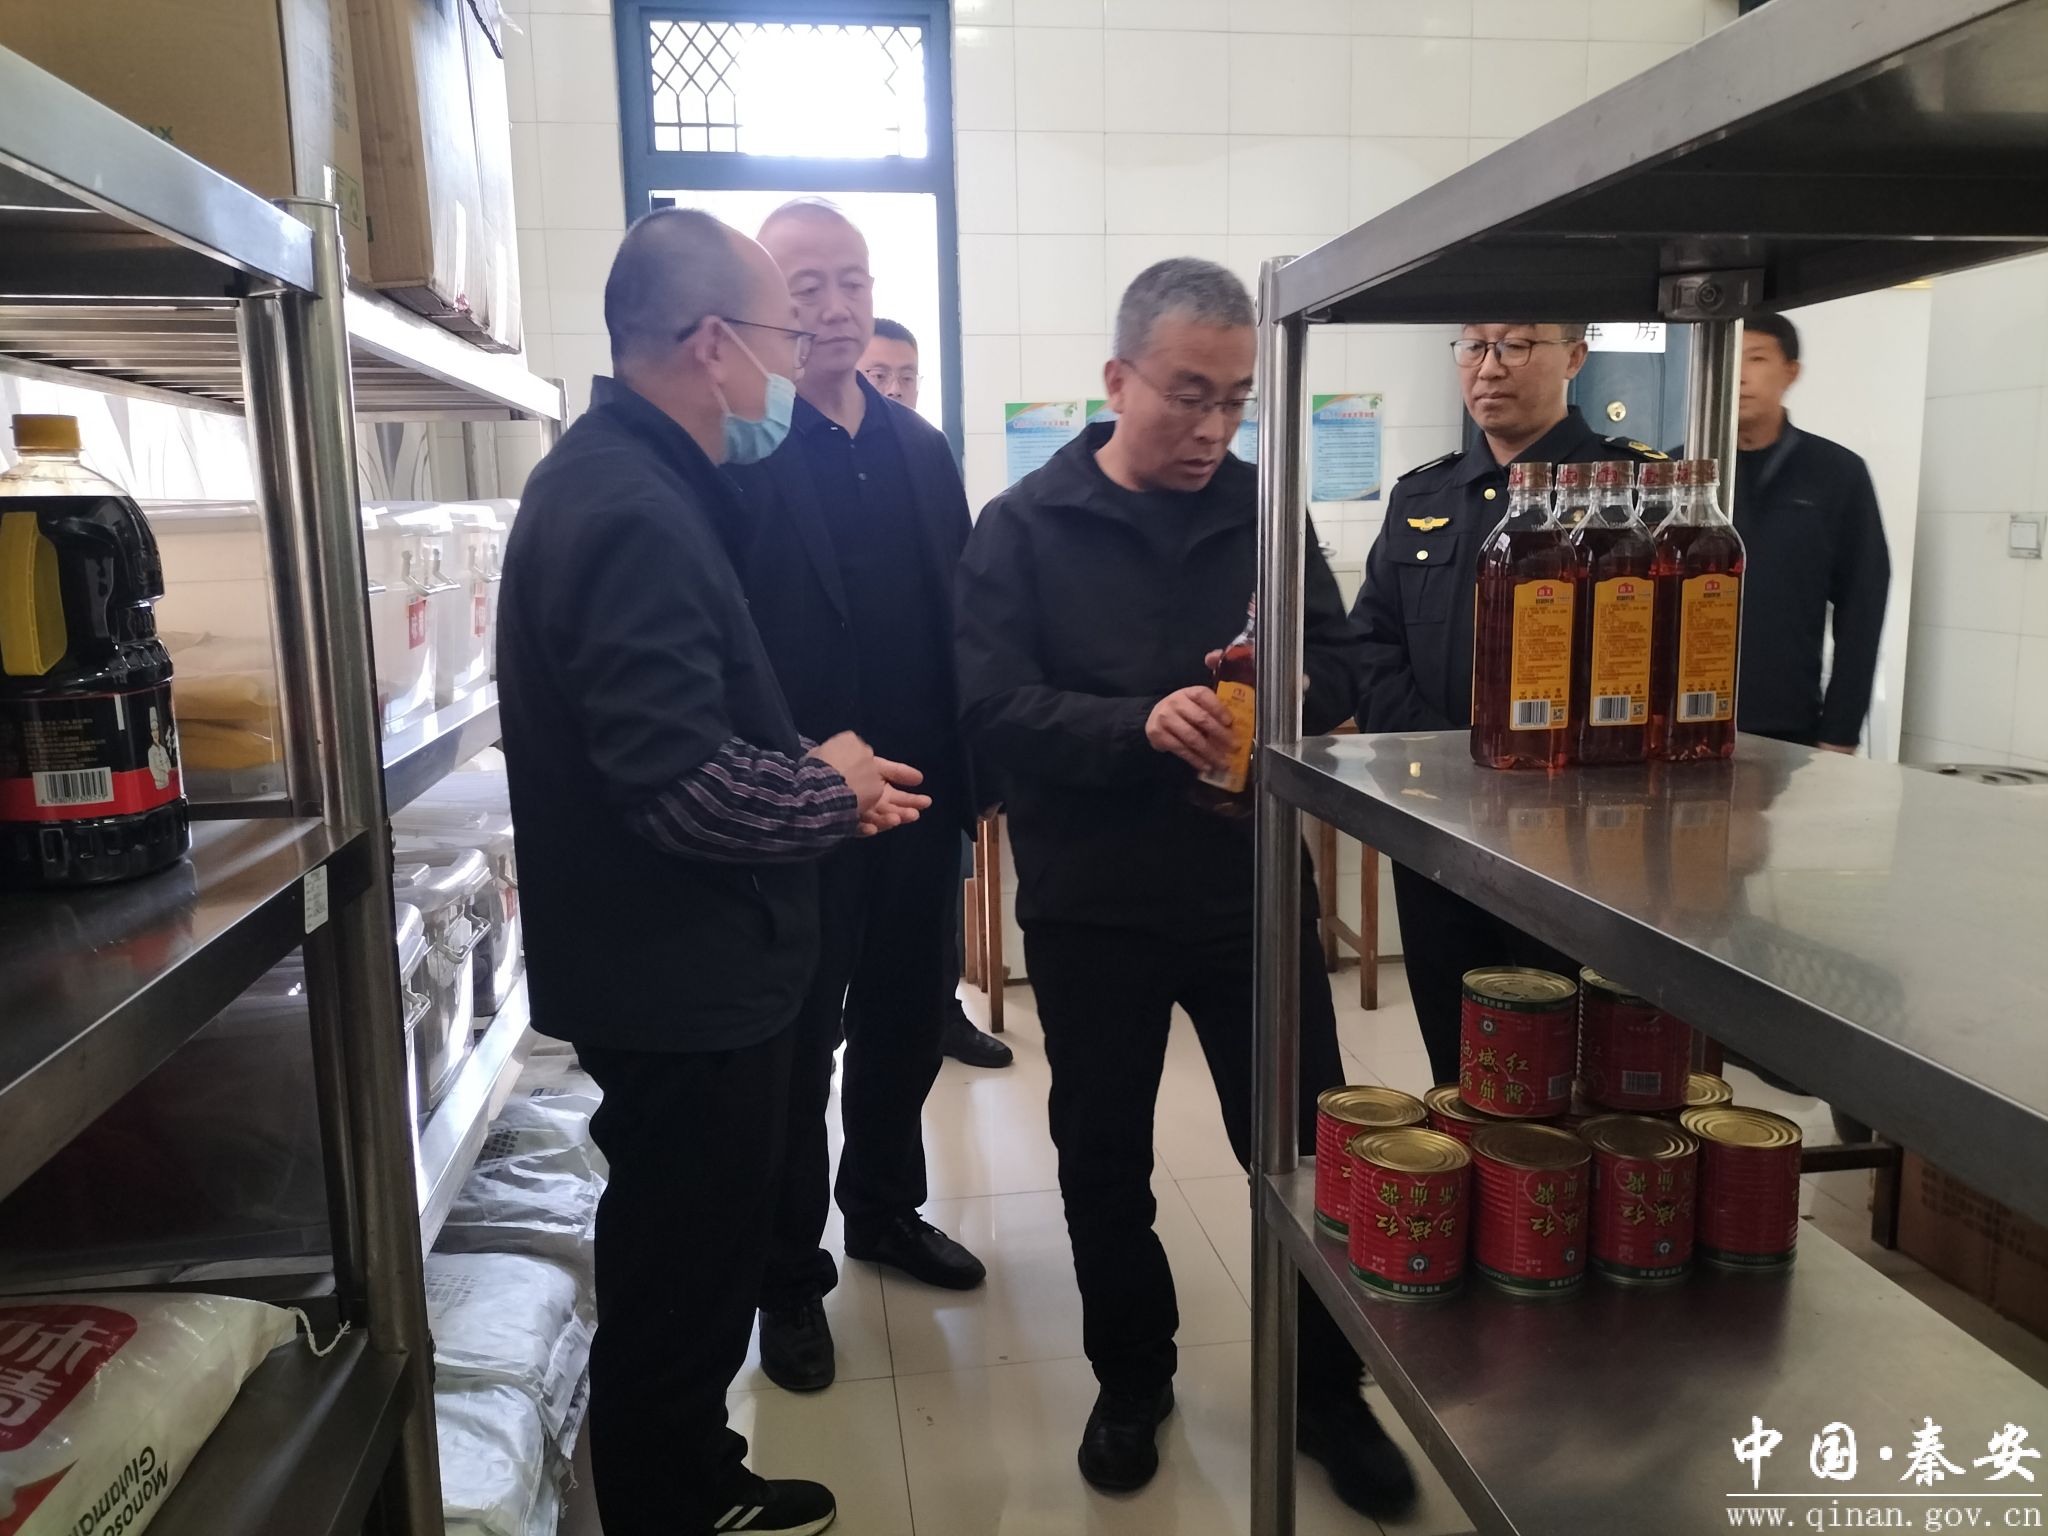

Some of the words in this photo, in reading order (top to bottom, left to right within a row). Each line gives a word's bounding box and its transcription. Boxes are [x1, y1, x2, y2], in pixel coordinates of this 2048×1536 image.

[1463, 1040, 1529, 1074] 西域红
[1376, 1213, 1456, 1242] 西域红
[67, 1446, 156, 1536] Glutama
